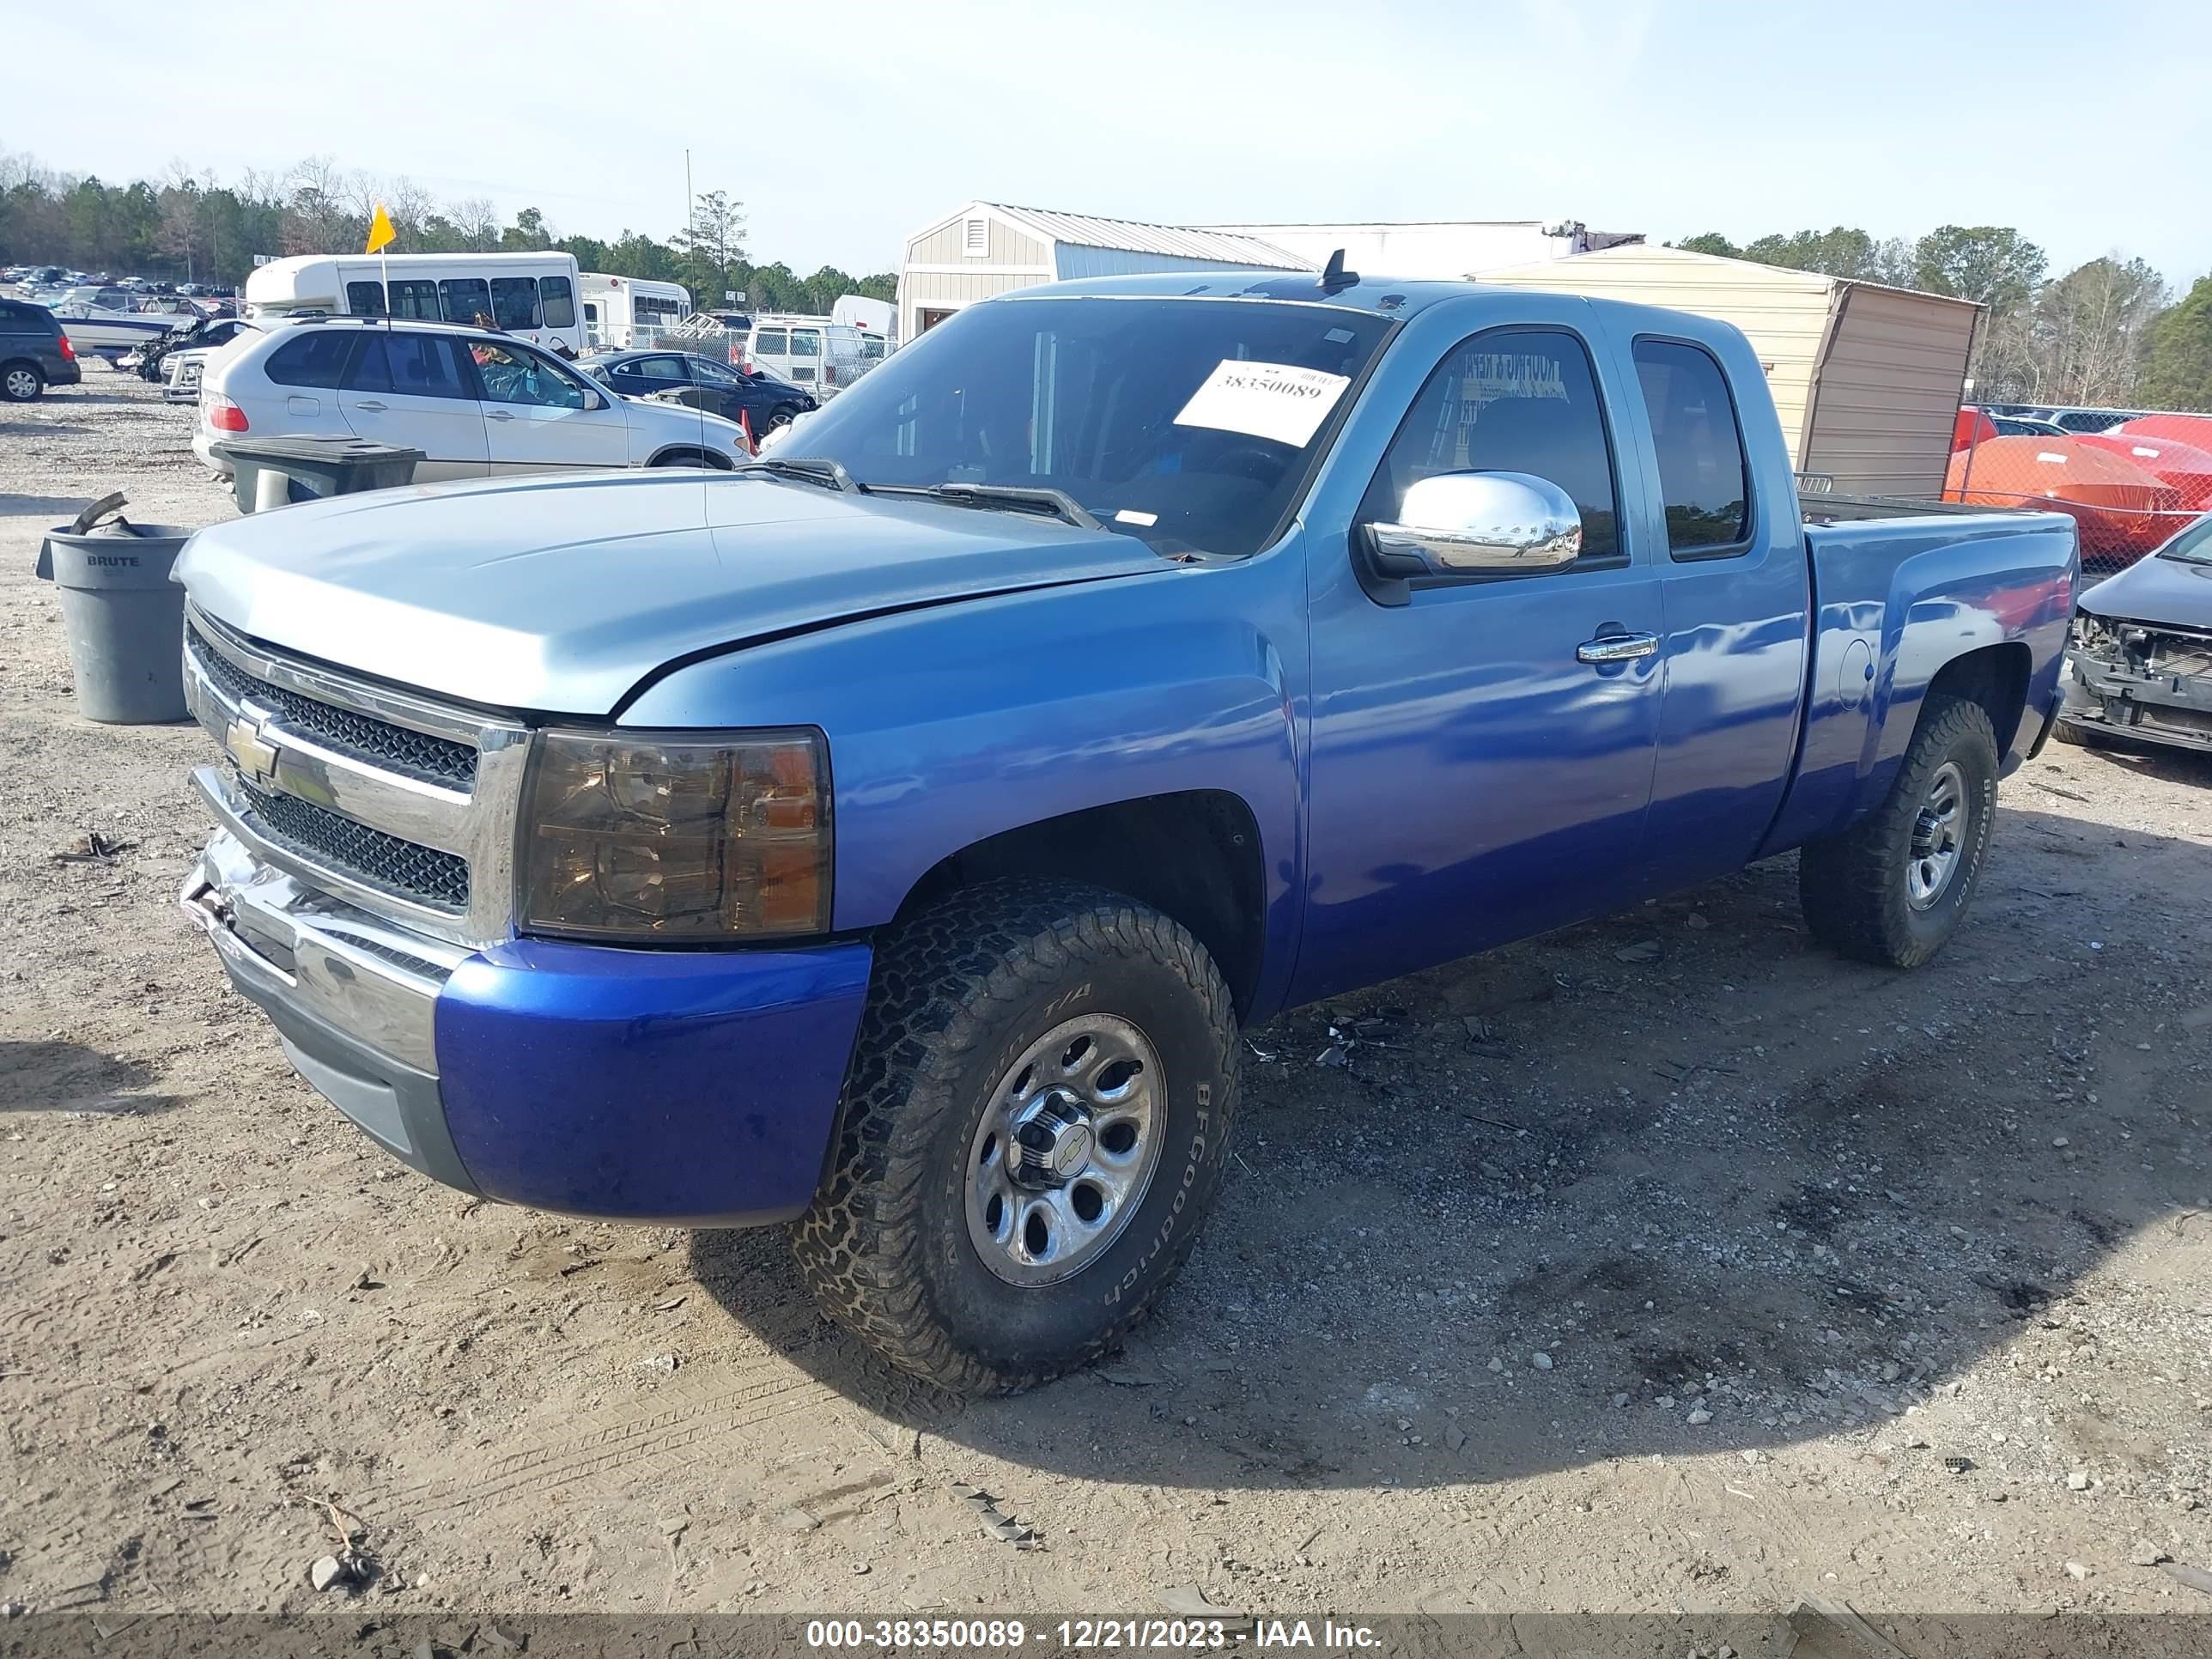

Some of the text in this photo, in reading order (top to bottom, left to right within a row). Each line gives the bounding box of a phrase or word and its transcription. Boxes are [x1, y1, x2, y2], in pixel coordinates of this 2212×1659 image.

[1217, 375, 1322, 398] 38350089
[87, 556, 140, 567] BRUTE
[1954, 778, 1991, 908] BFGoodrich
[1104, 1082, 1210, 1307] BFGoodrich
